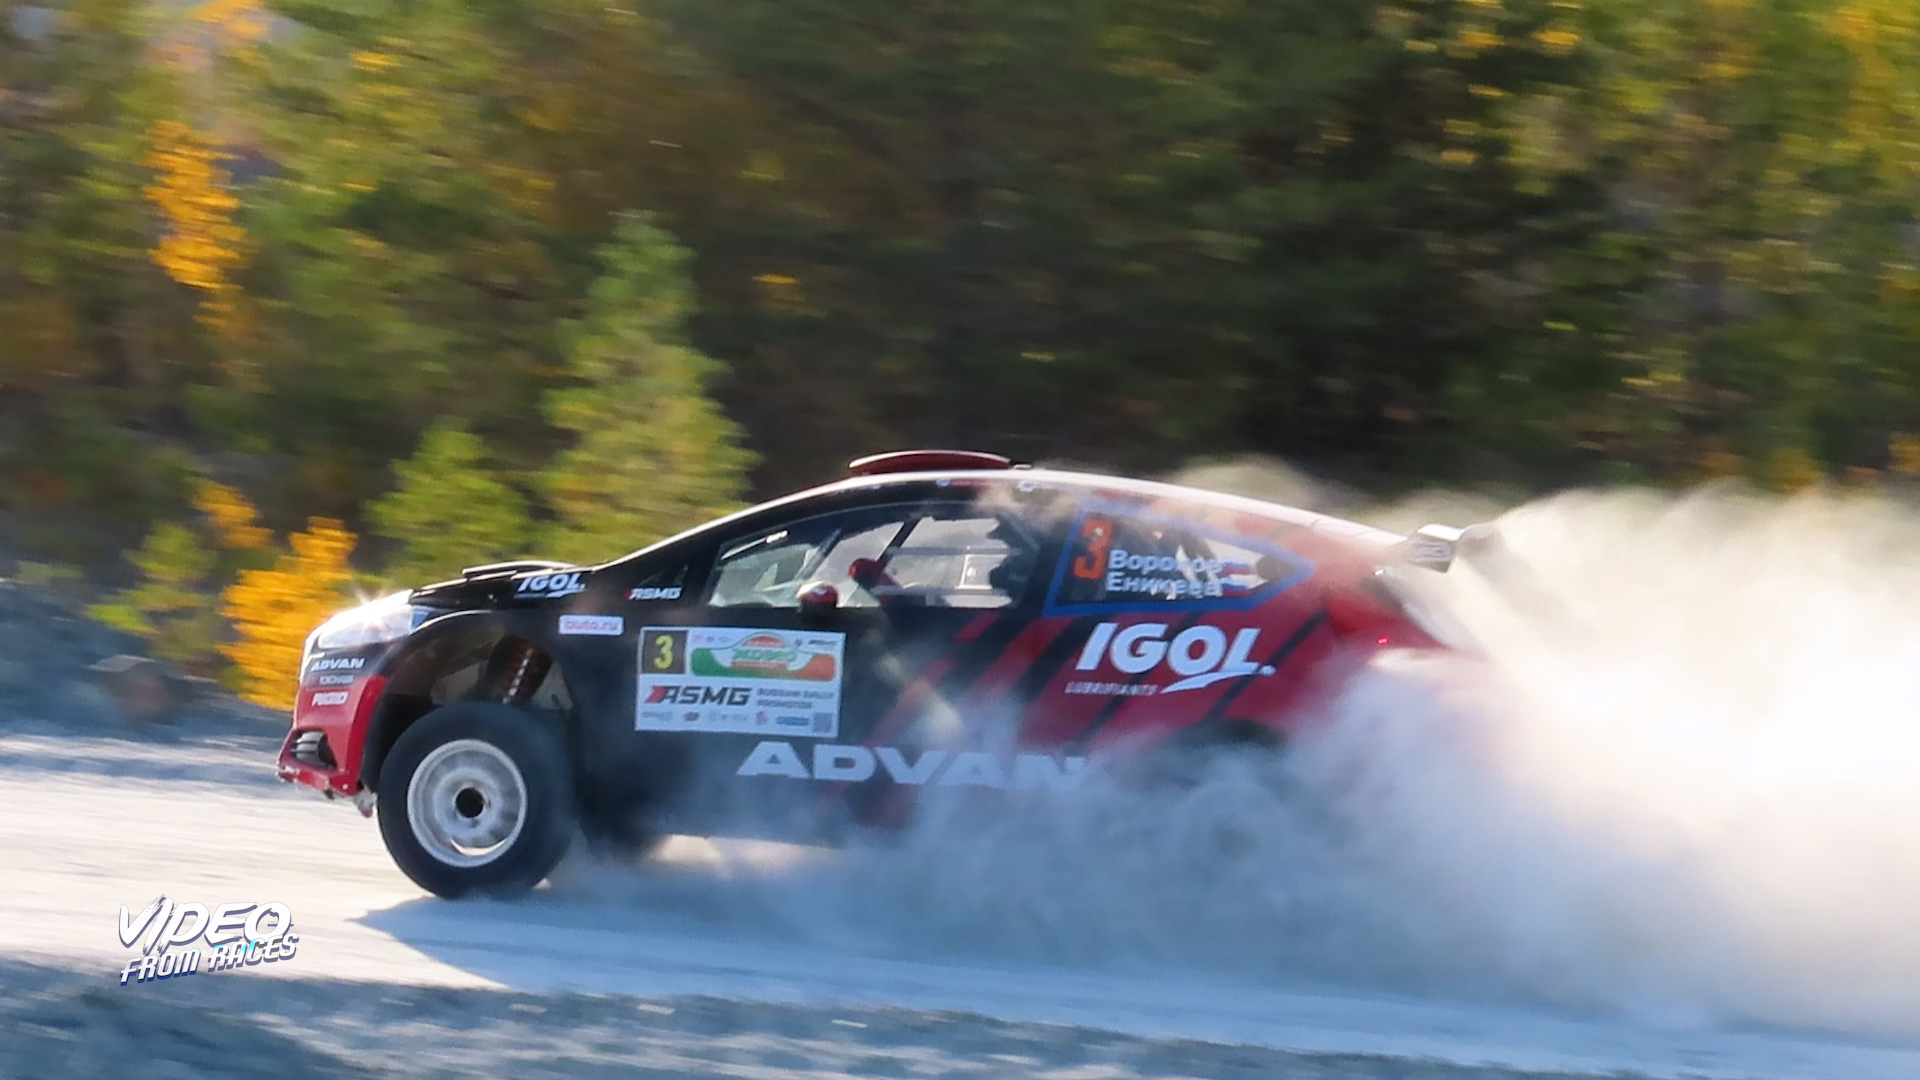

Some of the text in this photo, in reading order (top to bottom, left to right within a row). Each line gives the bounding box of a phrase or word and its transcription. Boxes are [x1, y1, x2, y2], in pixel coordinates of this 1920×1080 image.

[1073, 519, 1112, 579] 3
[627, 588, 682, 600] ASMG
[310, 658, 365, 672] ADVAN
[653, 634, 674, 669] 3
[646, 685, 752, 706] ASMG
[736, 741, 1087, 790] ADVAN
